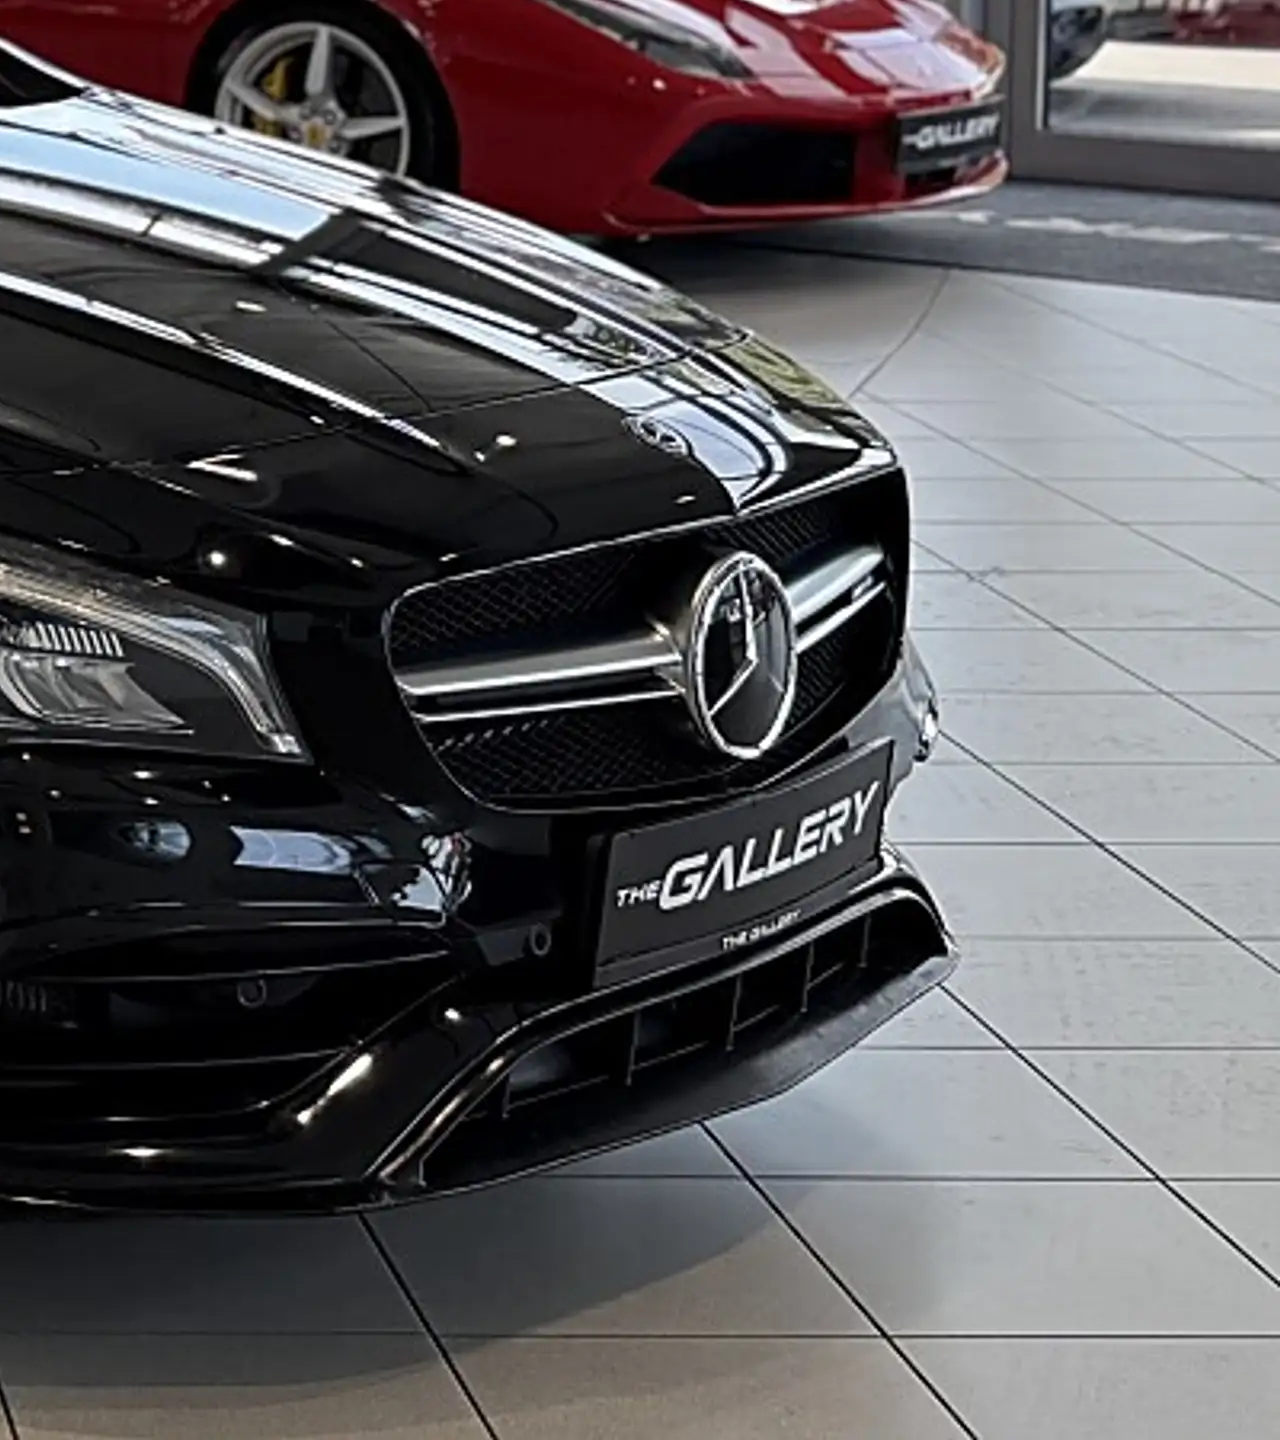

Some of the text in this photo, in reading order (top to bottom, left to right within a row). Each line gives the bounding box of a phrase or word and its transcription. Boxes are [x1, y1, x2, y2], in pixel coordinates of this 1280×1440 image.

[616, 780, 881, 910] THE GALLERY
[722, 931, 748, 951] THE
